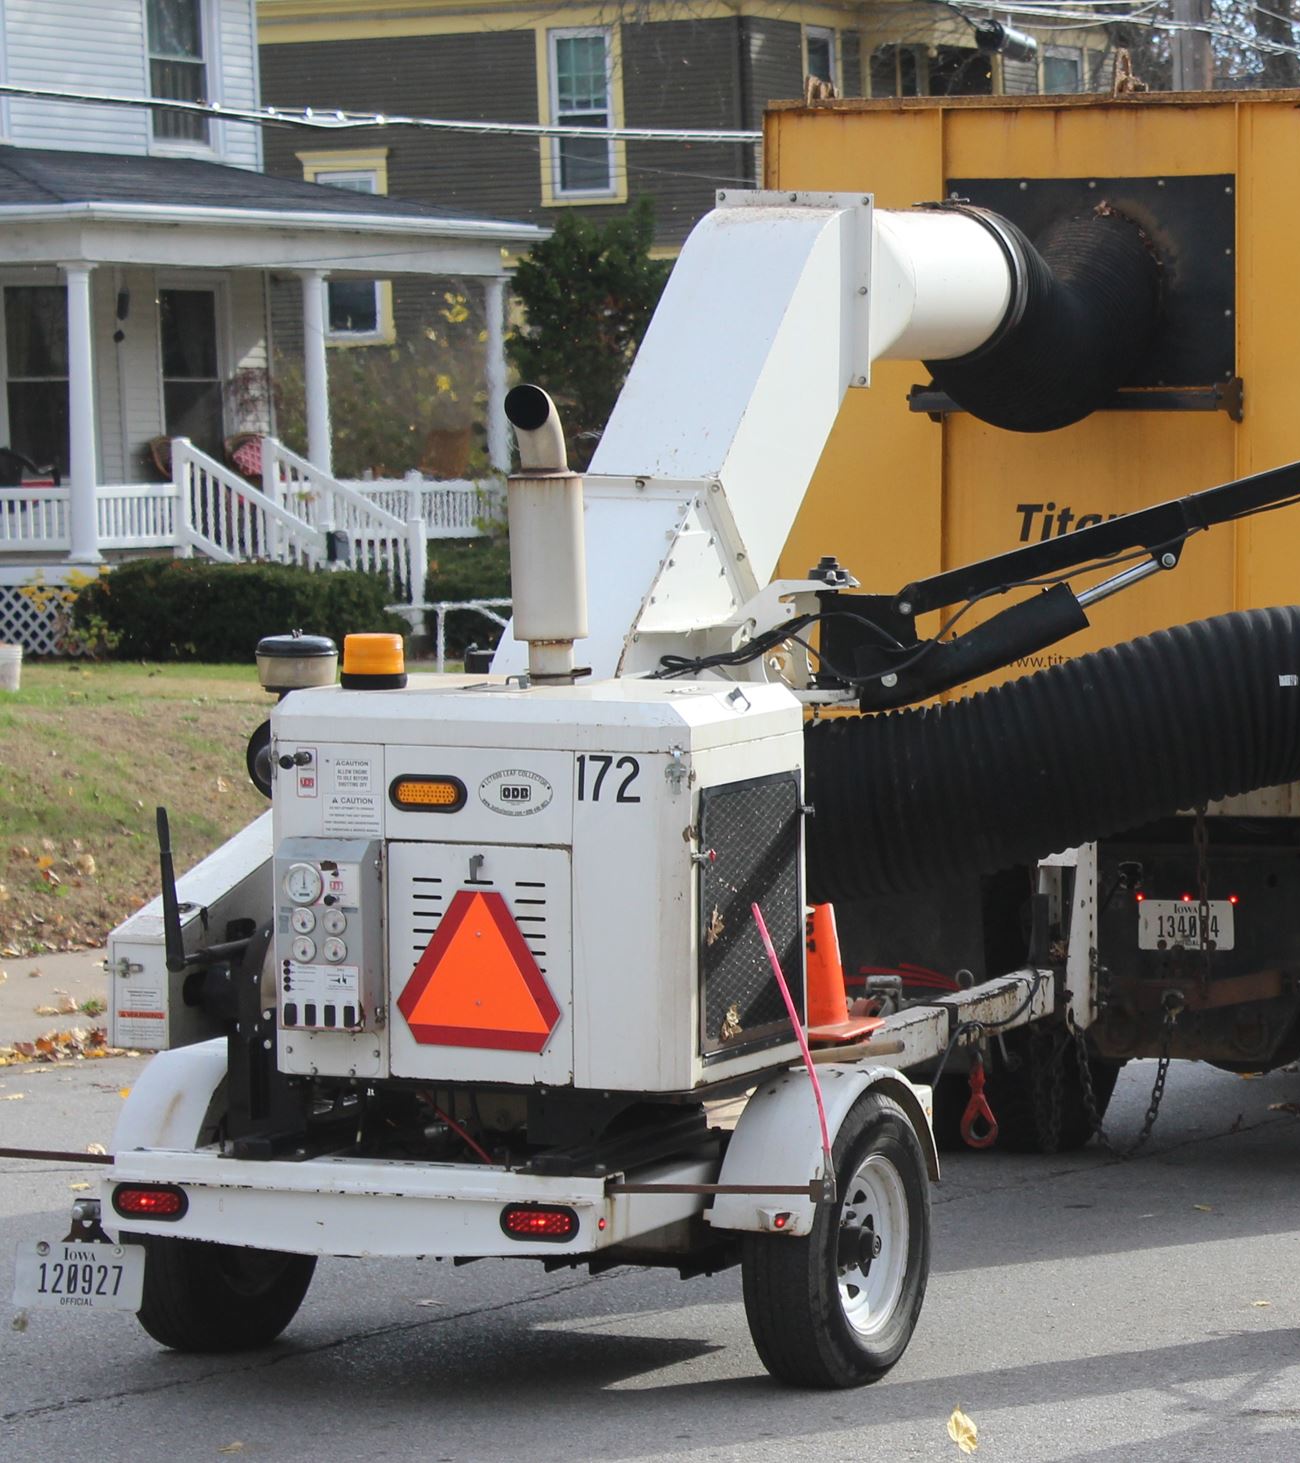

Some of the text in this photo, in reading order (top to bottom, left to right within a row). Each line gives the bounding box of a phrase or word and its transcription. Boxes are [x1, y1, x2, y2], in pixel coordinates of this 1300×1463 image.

[503, 769, 516, 778] LEAF
[517, 769, 548, 788] COLLECTOR
[576, 754, 641, 803] 172
[502, 787, 529, 799] ODB
[1174, 904, 1198, 914] IOWA
[1157, 915, 1220, 938] 13404
[64, 1247, 96, 1261] IOWA
[38, 1262, 123, 1296] 120927
[60, 1297, 93, 1307] OFFICIAL
